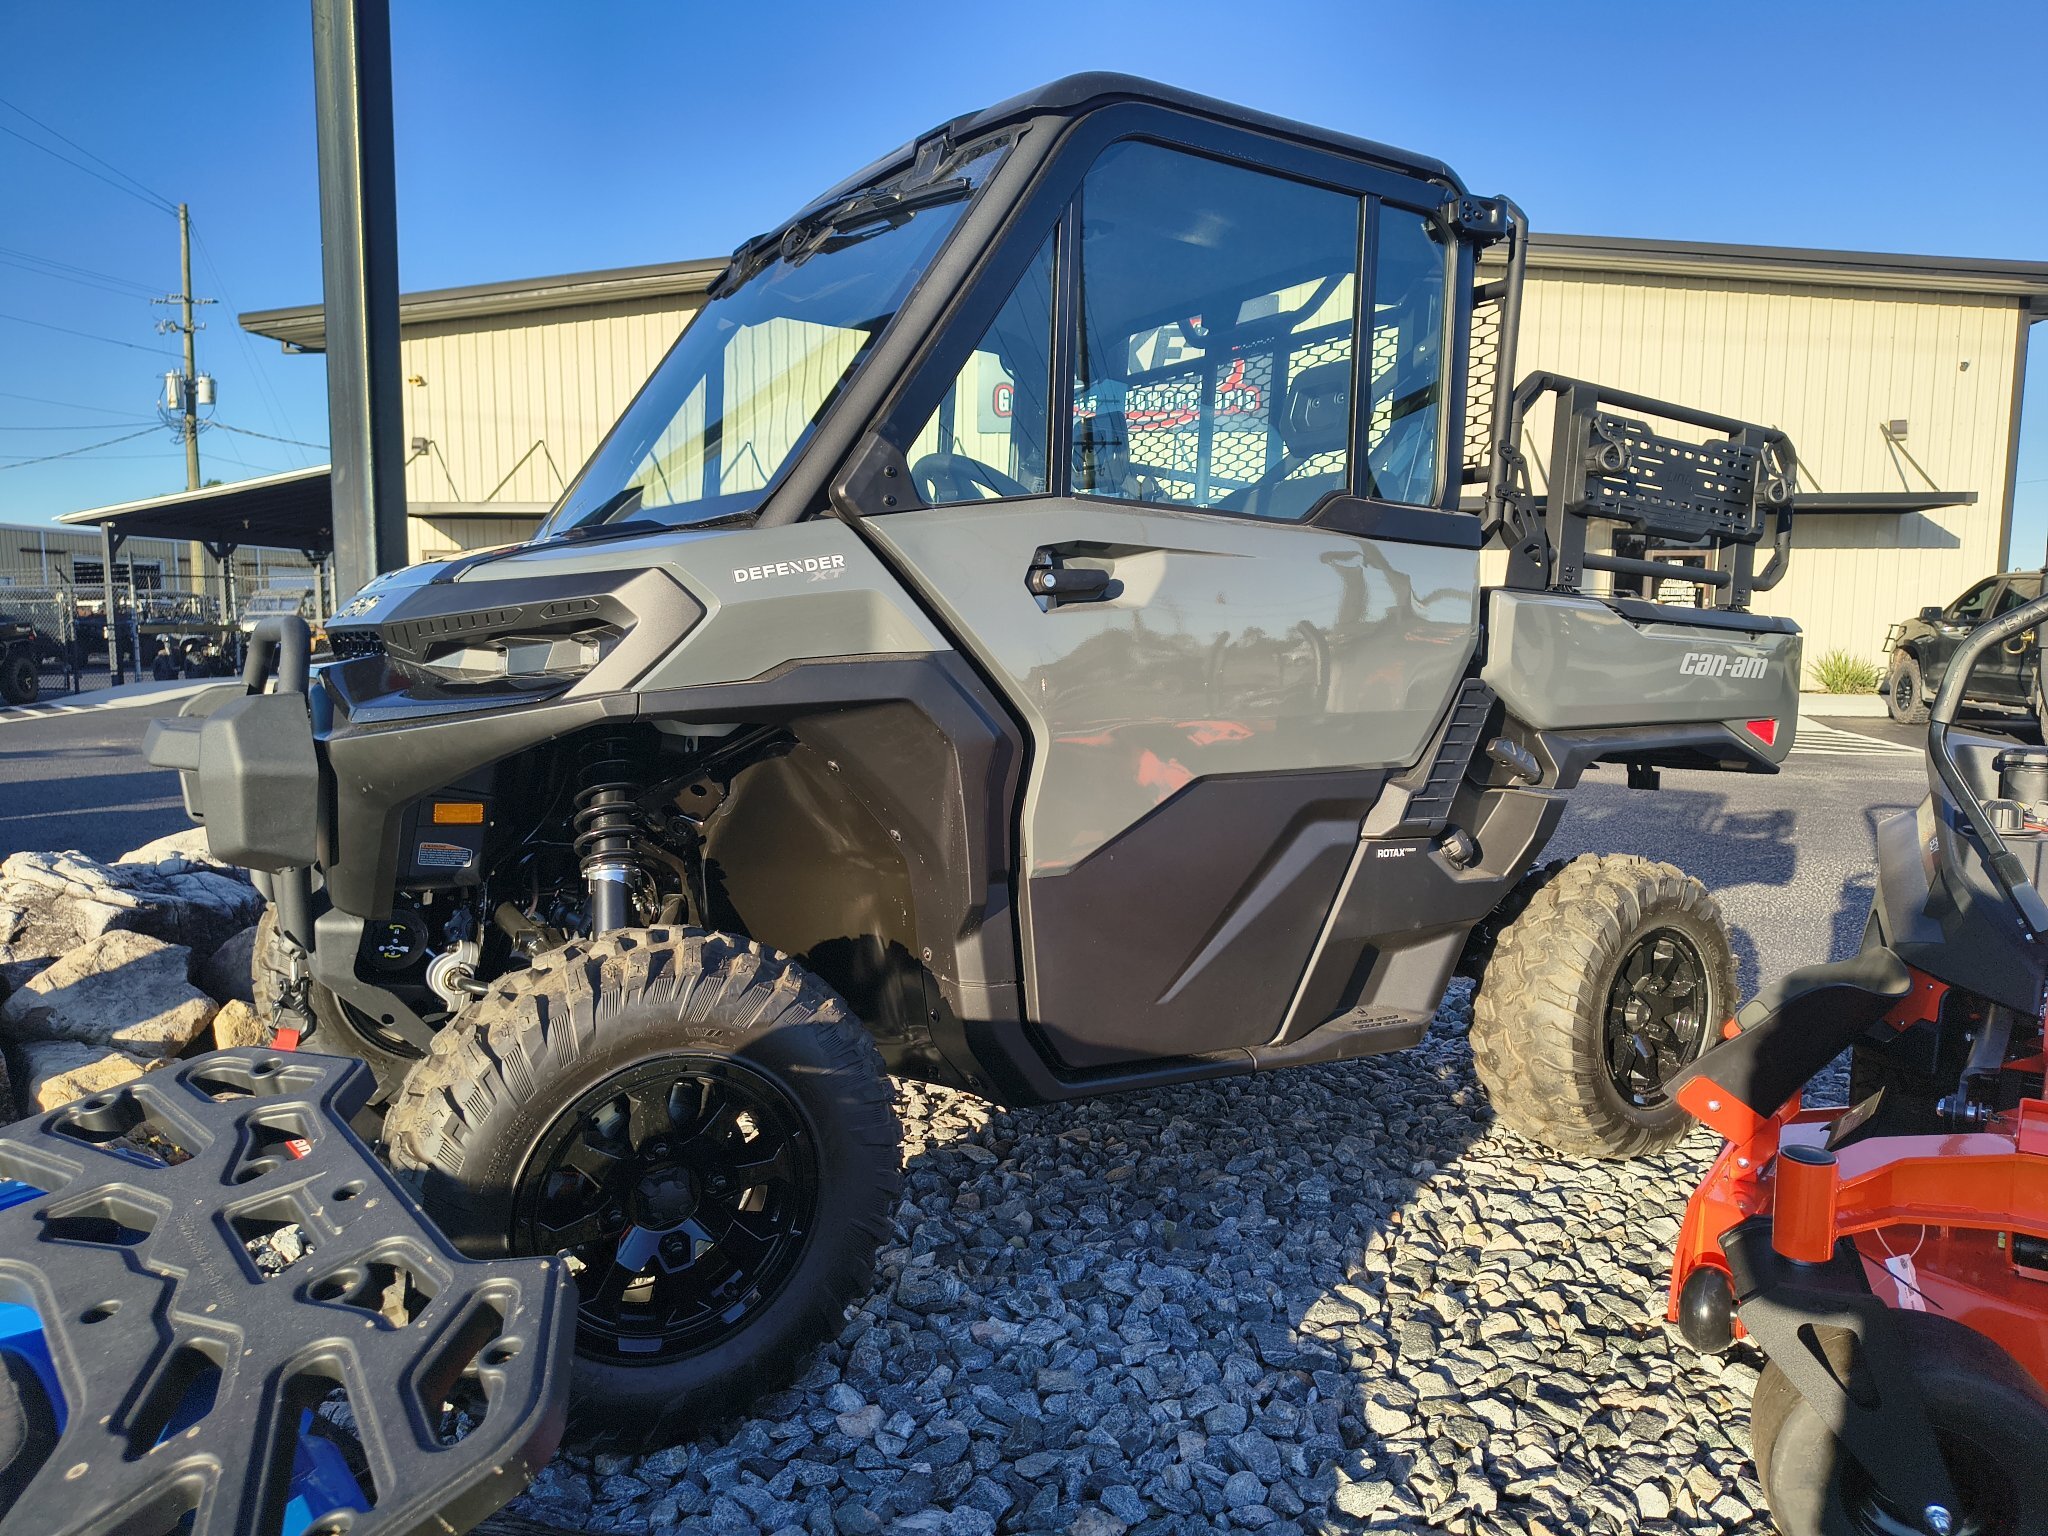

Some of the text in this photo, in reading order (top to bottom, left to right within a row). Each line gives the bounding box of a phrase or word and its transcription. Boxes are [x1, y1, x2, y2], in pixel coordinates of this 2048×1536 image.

[733, 554, 845, 583] DEFENDER
[807, 567, 846, 583] XT
[1679, 652, 1769, 680] can-am
[1377, 848, 1405, 858] ROTAX
